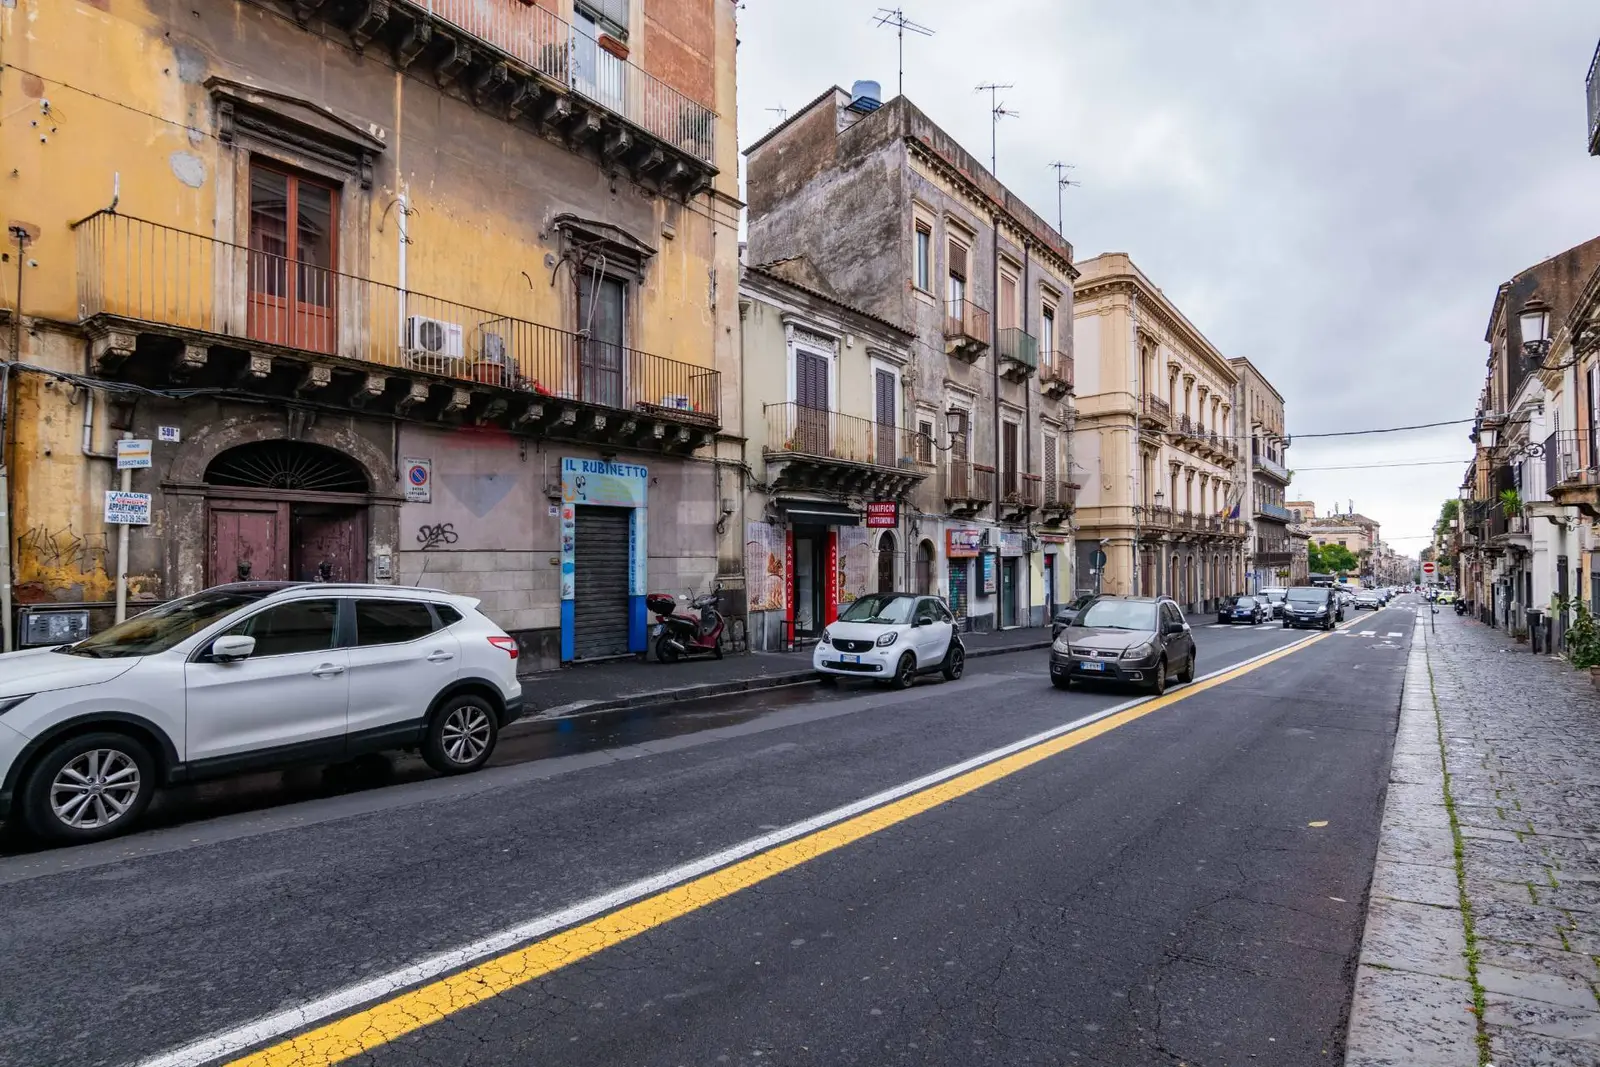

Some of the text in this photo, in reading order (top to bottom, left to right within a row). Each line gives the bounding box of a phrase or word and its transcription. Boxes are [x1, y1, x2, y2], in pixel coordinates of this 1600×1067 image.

[565, 459, 647, 478] IL RUBINETTO
[108, 503, 148, 513] APPARTAMENTO
[868, 504, 896, 513] PANIFICIO
[867, 516, 896, 525] GASTRONOMIA
